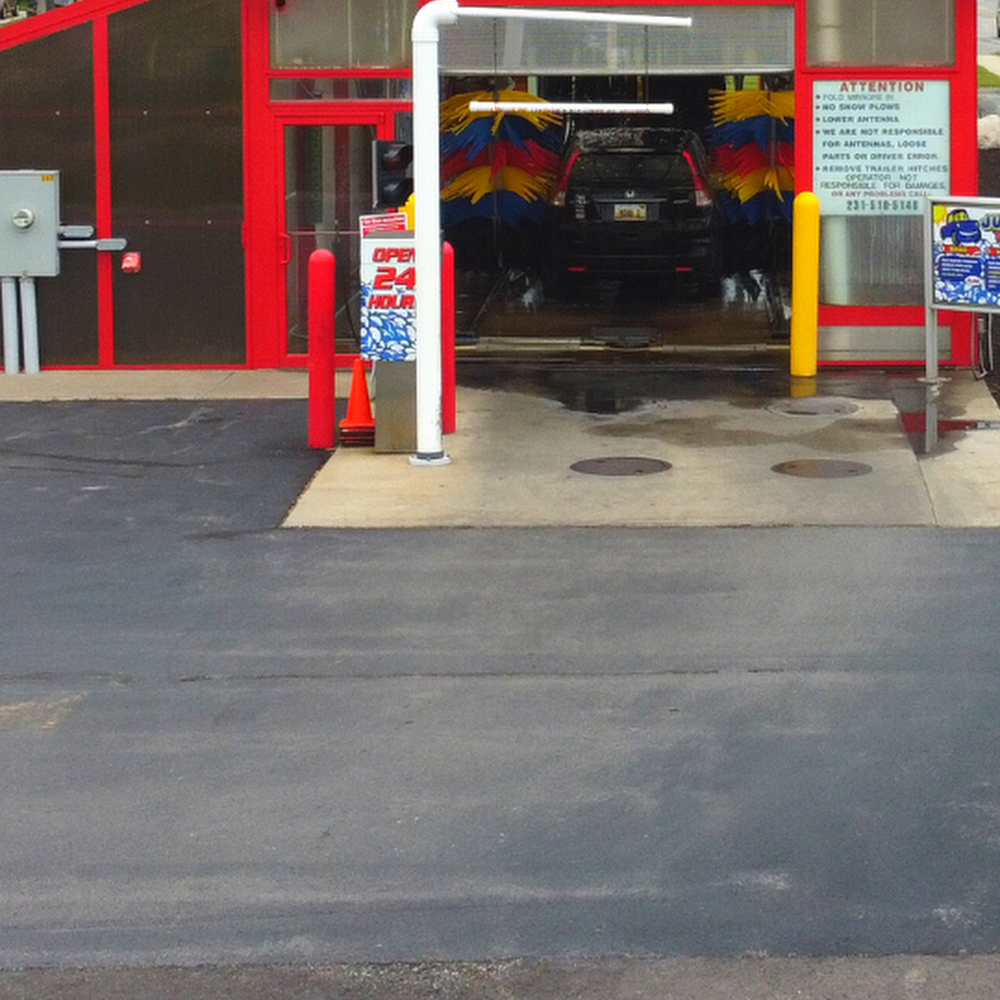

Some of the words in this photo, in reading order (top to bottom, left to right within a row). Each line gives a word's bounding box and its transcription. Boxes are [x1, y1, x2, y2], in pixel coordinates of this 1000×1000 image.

[840, 81, 925, 92] ATTENTION
[822, 128, 836, 136] WE
[839, 128, 857, 136] ARE
[860, 128, 878, 136] NOT
[882, 128, 944, 136] RESPONSIBLE
[822, 140, 840, 148] FOR
[898, 140, 927, 148] LOOSE
[373, 267, 416, 290] 24
